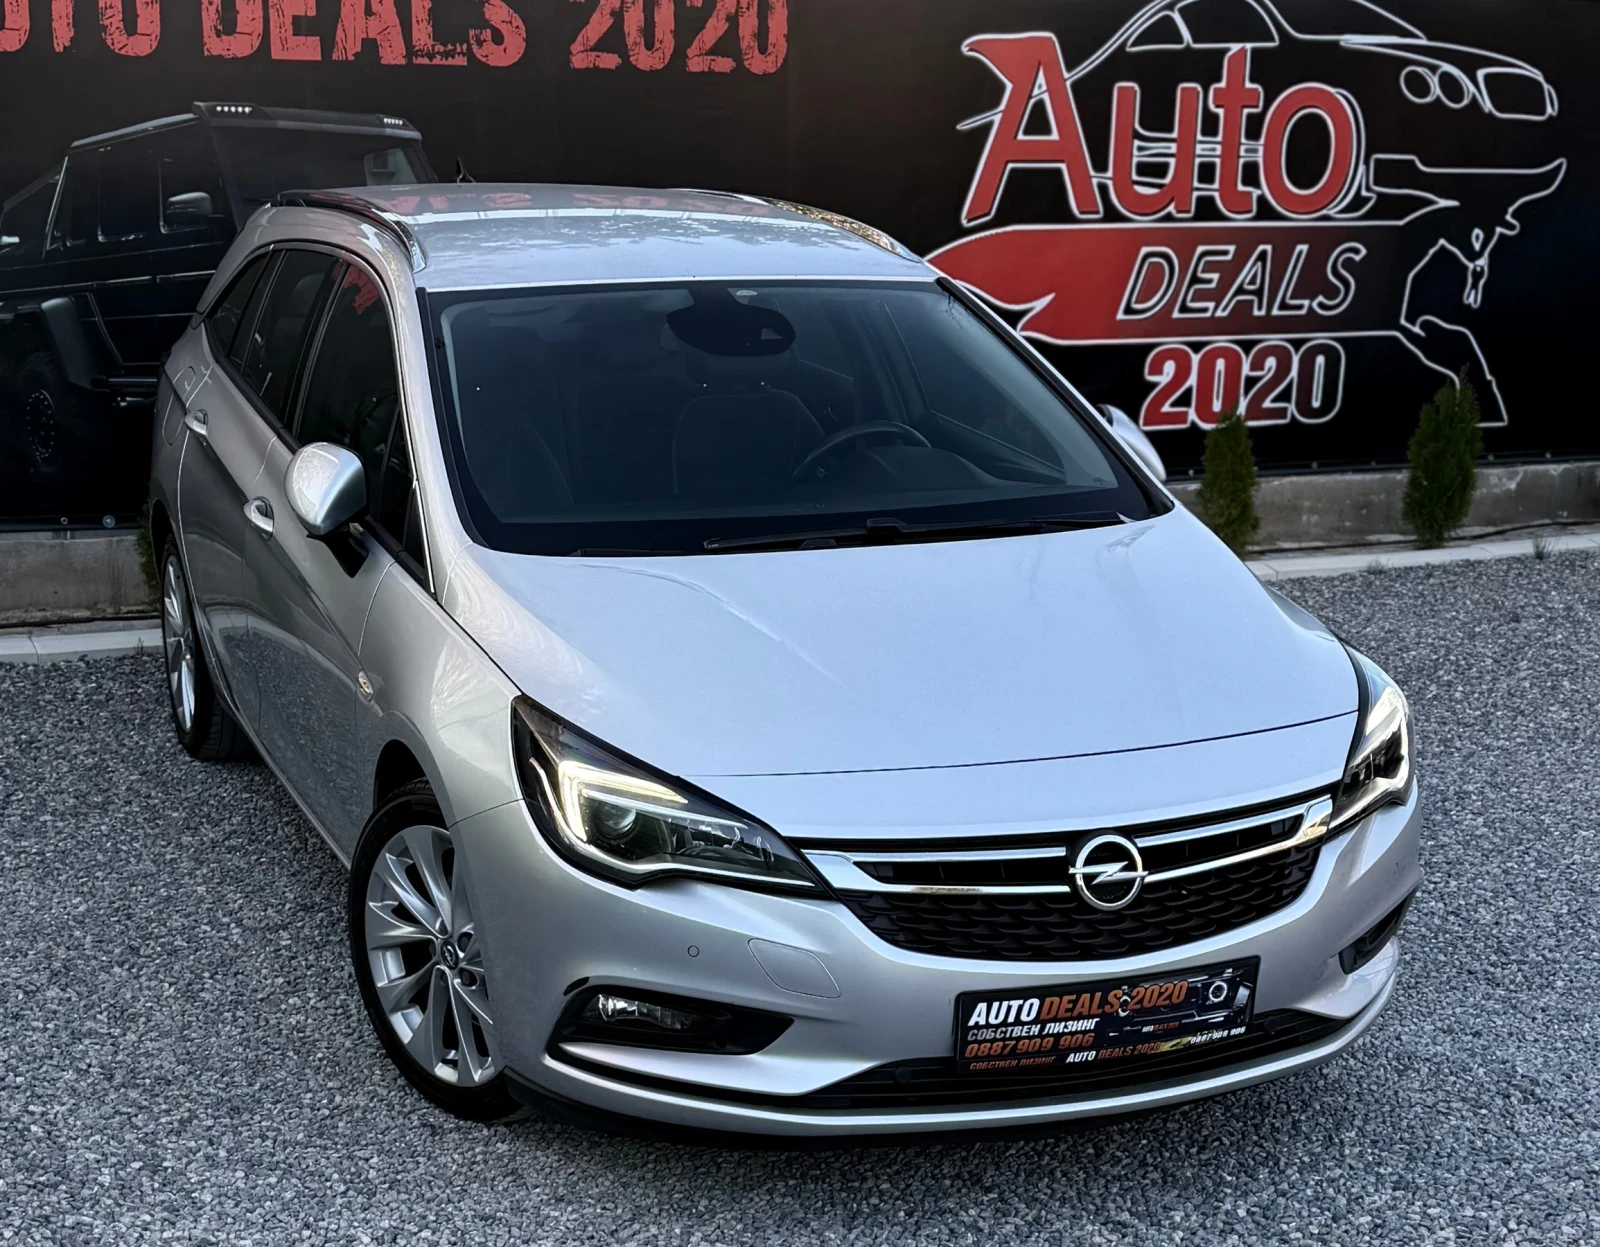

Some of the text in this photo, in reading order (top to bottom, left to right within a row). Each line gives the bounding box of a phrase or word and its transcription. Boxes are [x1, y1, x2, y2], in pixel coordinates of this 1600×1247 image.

[962, 33, 1355, 224] Auto
[1116, 242, 1366, 320] DEALS
[1139, 339, 1345, 431] 2020
[967, 980, 1189, 1026] AUTO DEALS 2020
[967, 1018, 1100, 1041] СОБСТВЕН ЛИЗИНГ
[1058, 1033, 1095, 1049] 906
[1065, 1051, 1096, 1063] AUTO
